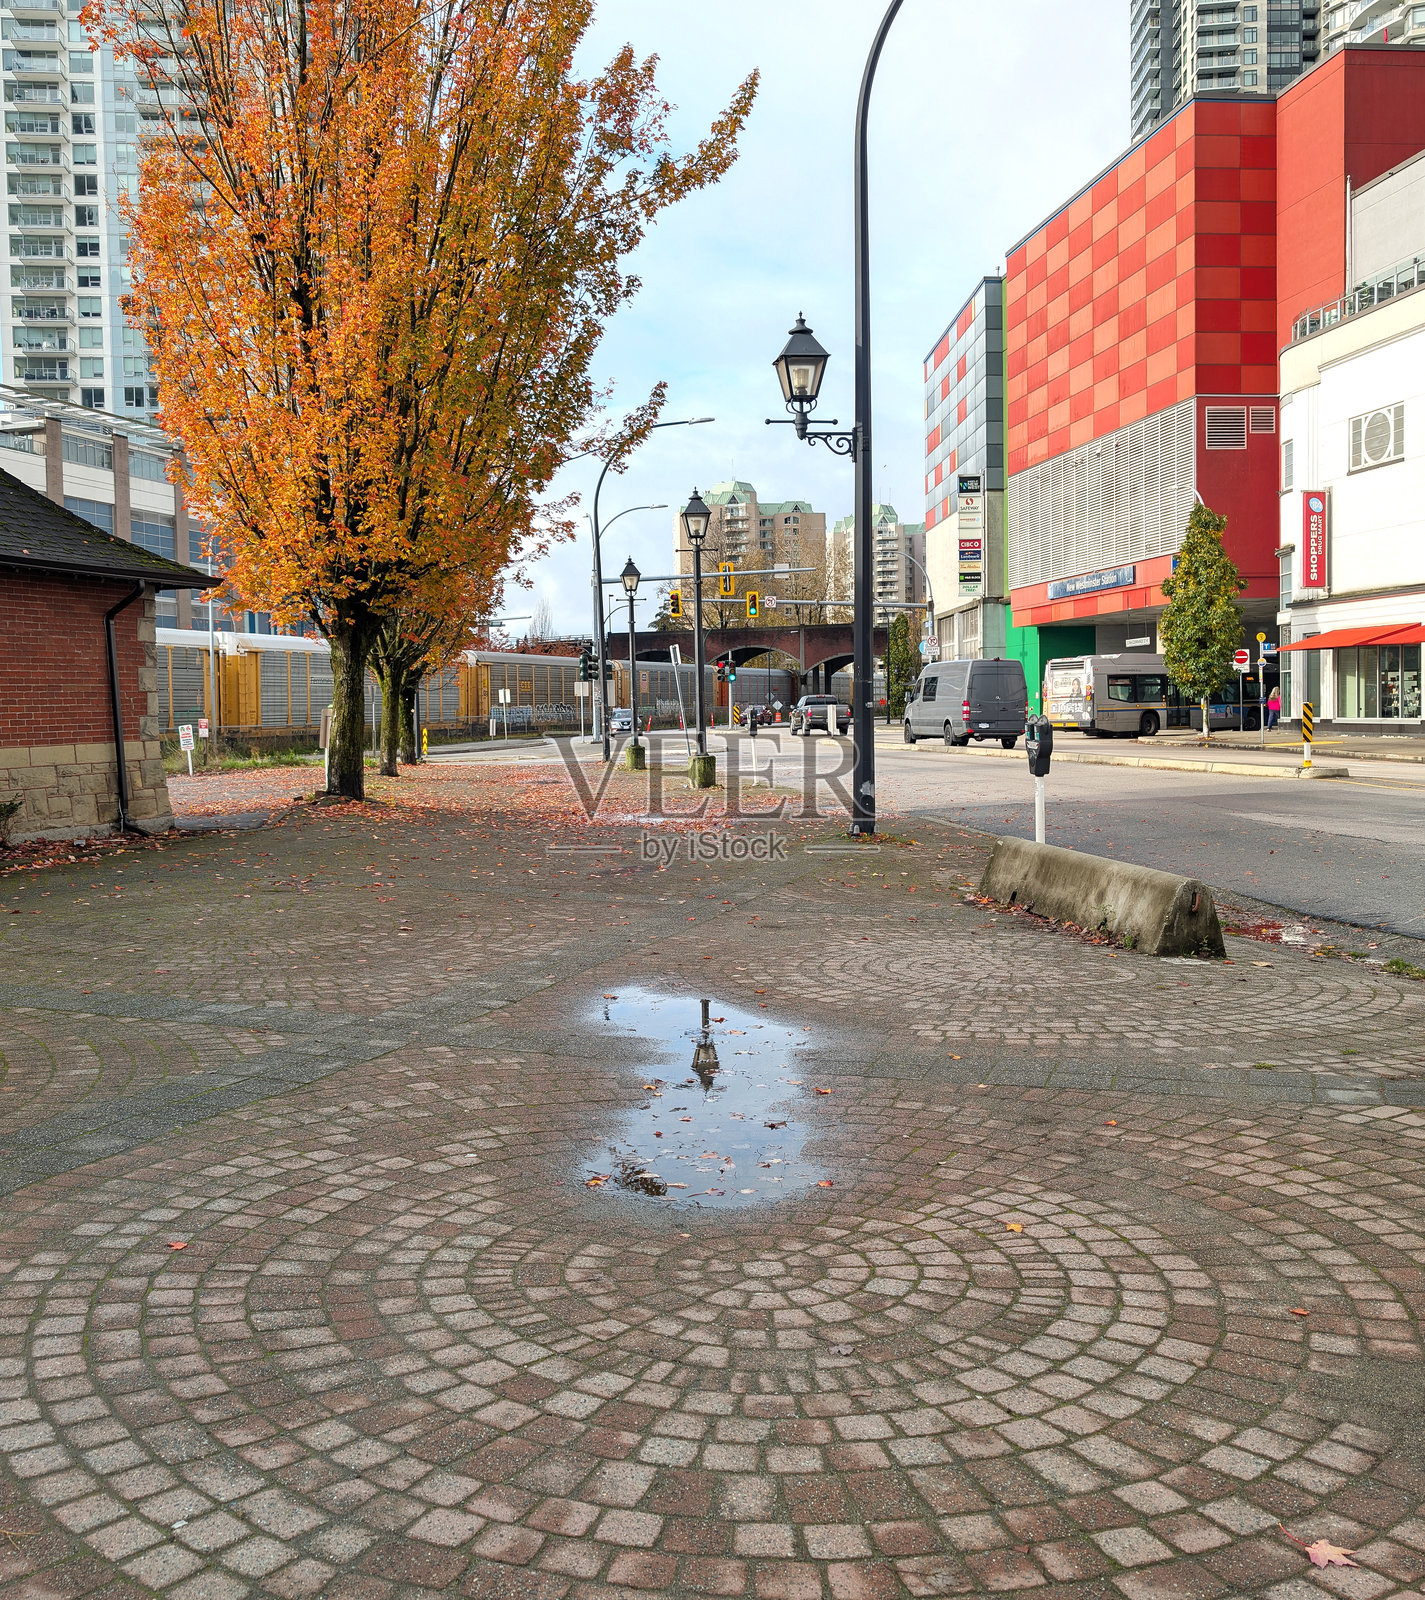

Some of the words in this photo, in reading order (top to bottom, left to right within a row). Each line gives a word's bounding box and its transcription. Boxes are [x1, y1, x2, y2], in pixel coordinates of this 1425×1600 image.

[1310, 514, 1318, 581] SHOPPERS
[1066, 582, 1076, 593] New
[1075, 577, 1101, 591] Westminster
[1101, 573, 1118, 585] Station
